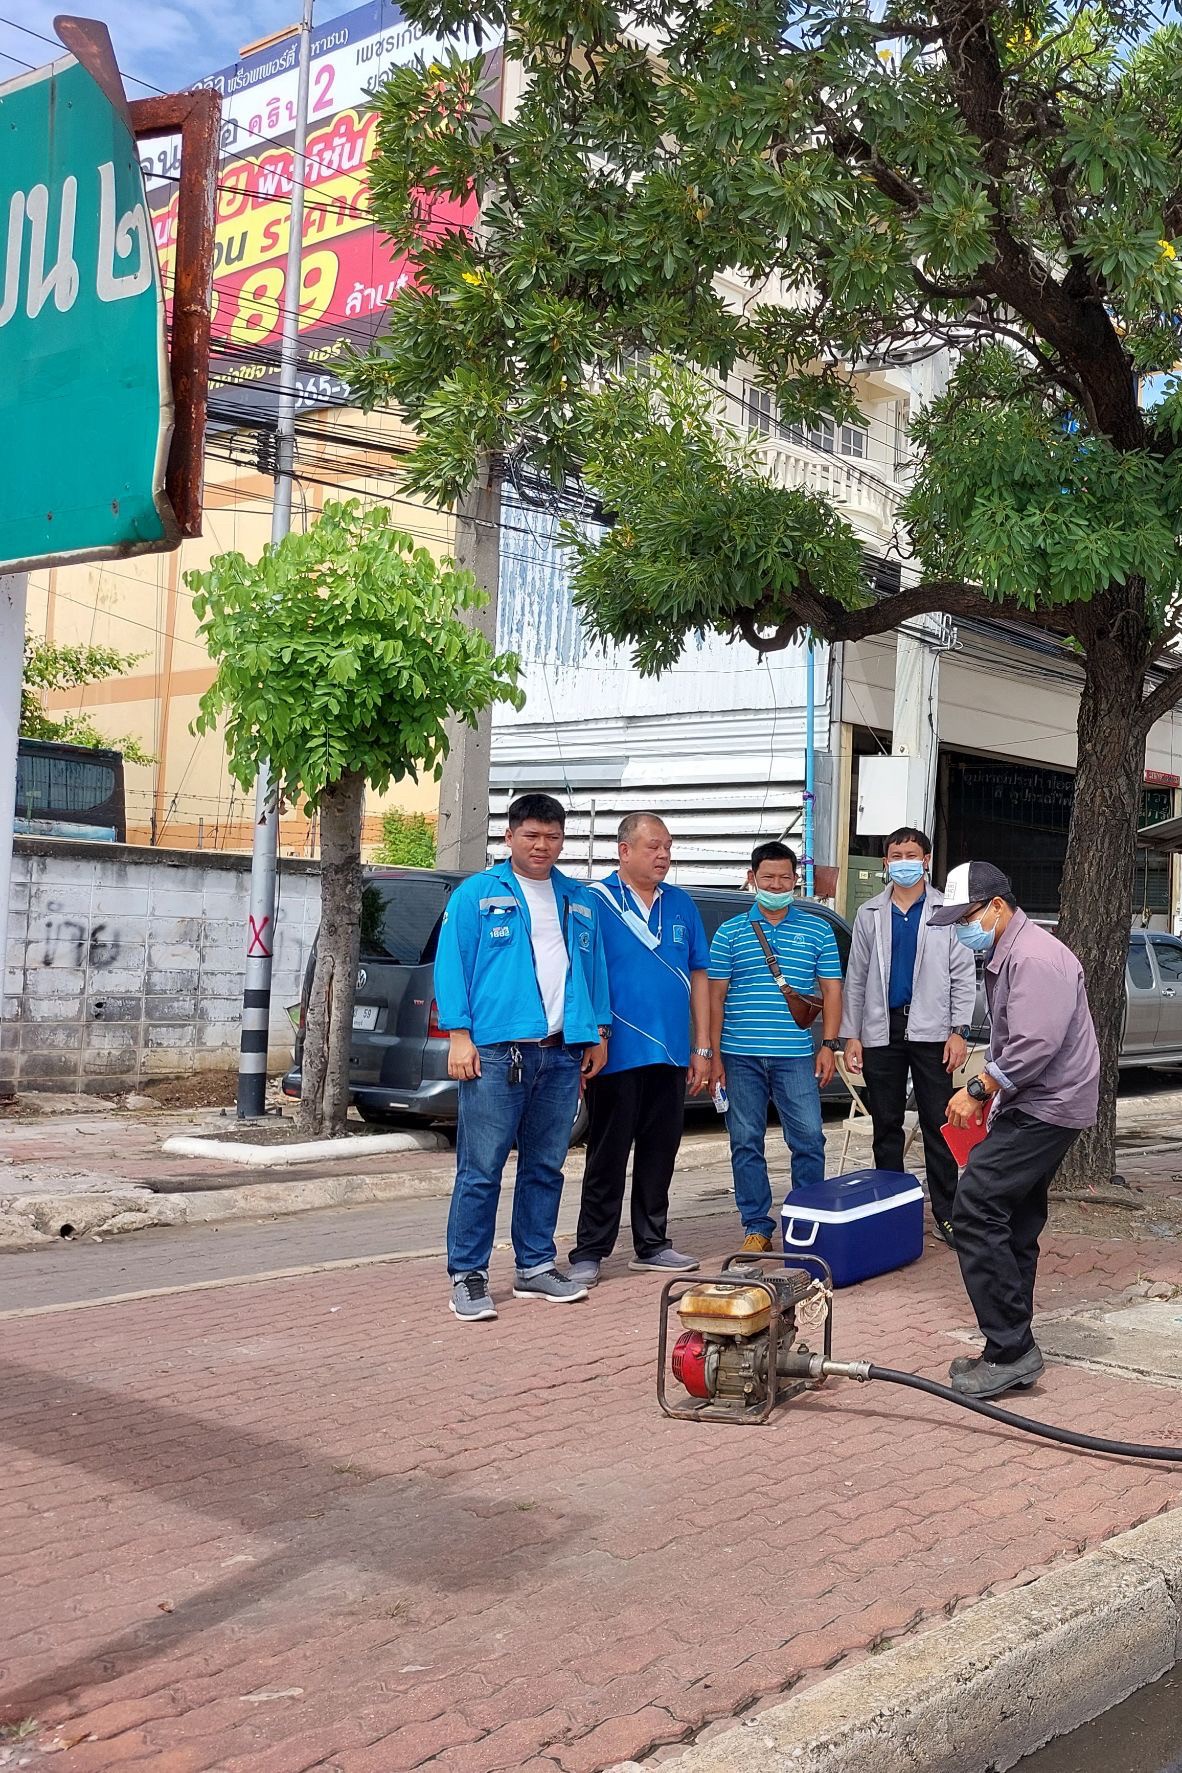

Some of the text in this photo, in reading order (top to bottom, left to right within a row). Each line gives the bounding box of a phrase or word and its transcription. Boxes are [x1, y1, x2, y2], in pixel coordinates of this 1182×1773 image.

[356, 26, 424, 66] เพชรเกษ
[312, 64, 336, 114] 2
[96, 160, 152, 302] ๒
